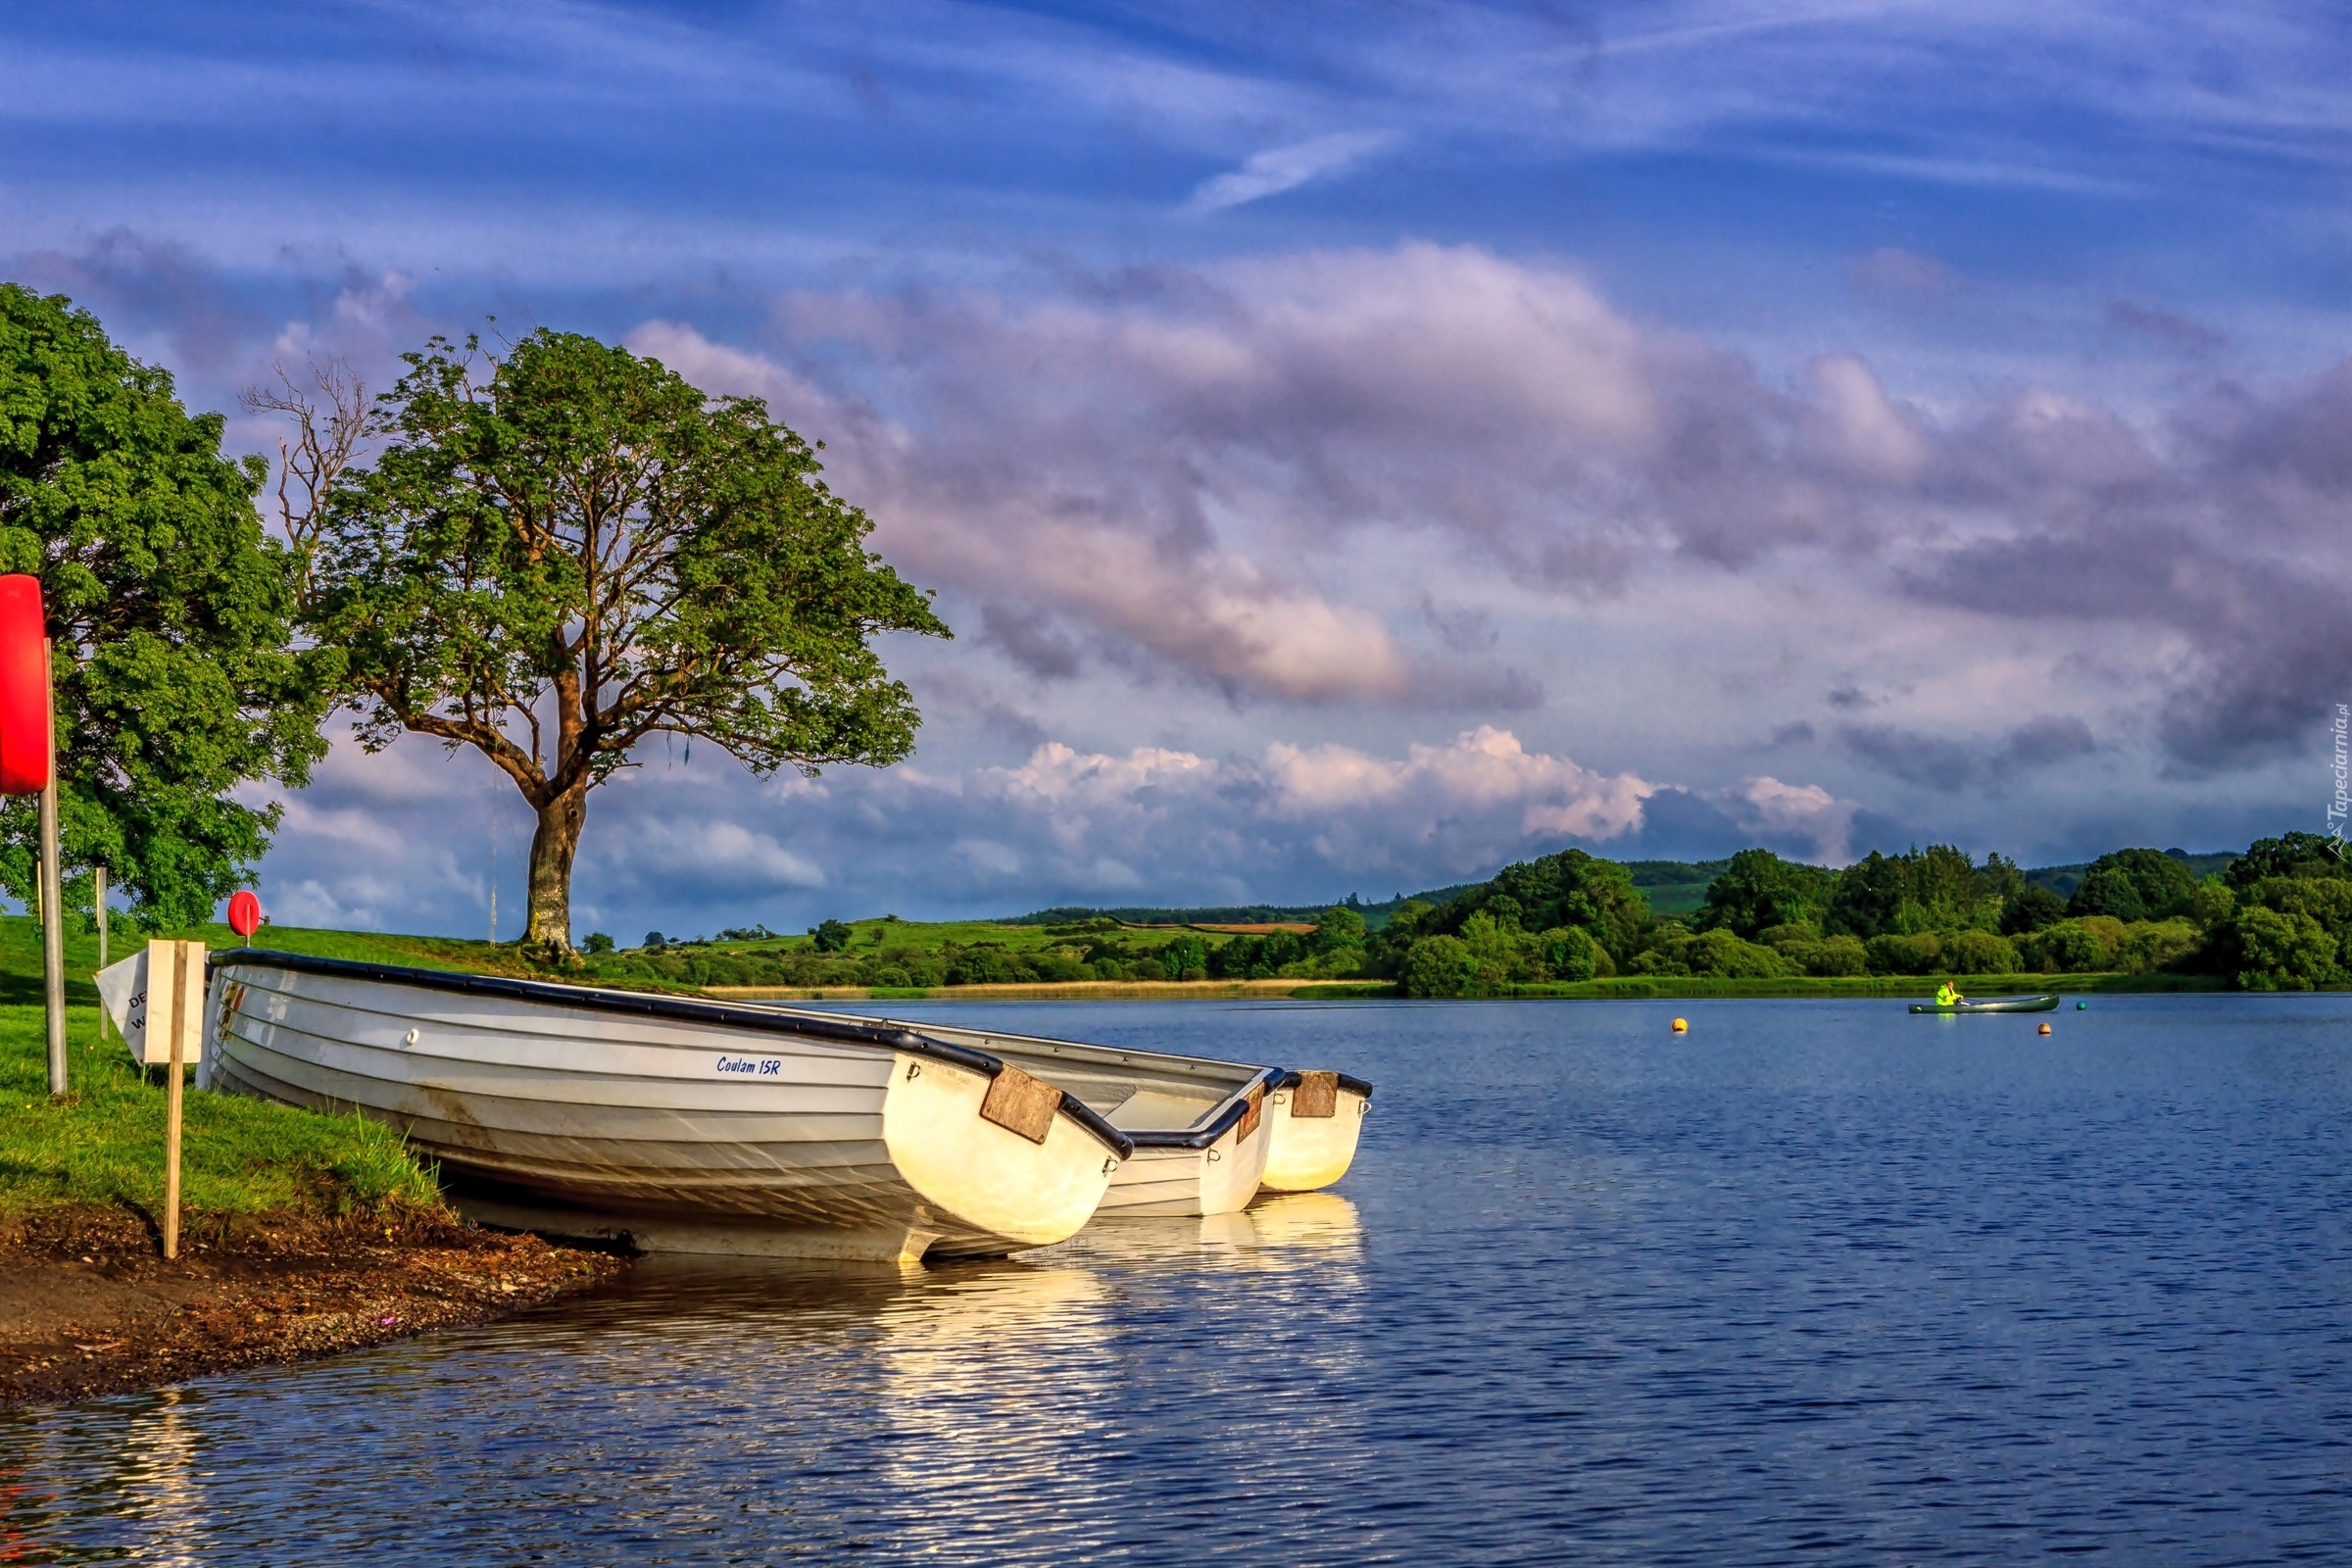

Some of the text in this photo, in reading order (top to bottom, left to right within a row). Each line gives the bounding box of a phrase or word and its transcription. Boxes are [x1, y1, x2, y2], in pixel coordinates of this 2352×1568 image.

[128, 990, 147, 1008] DE
[716, 1055, 781, 1075] Coulam 15R
